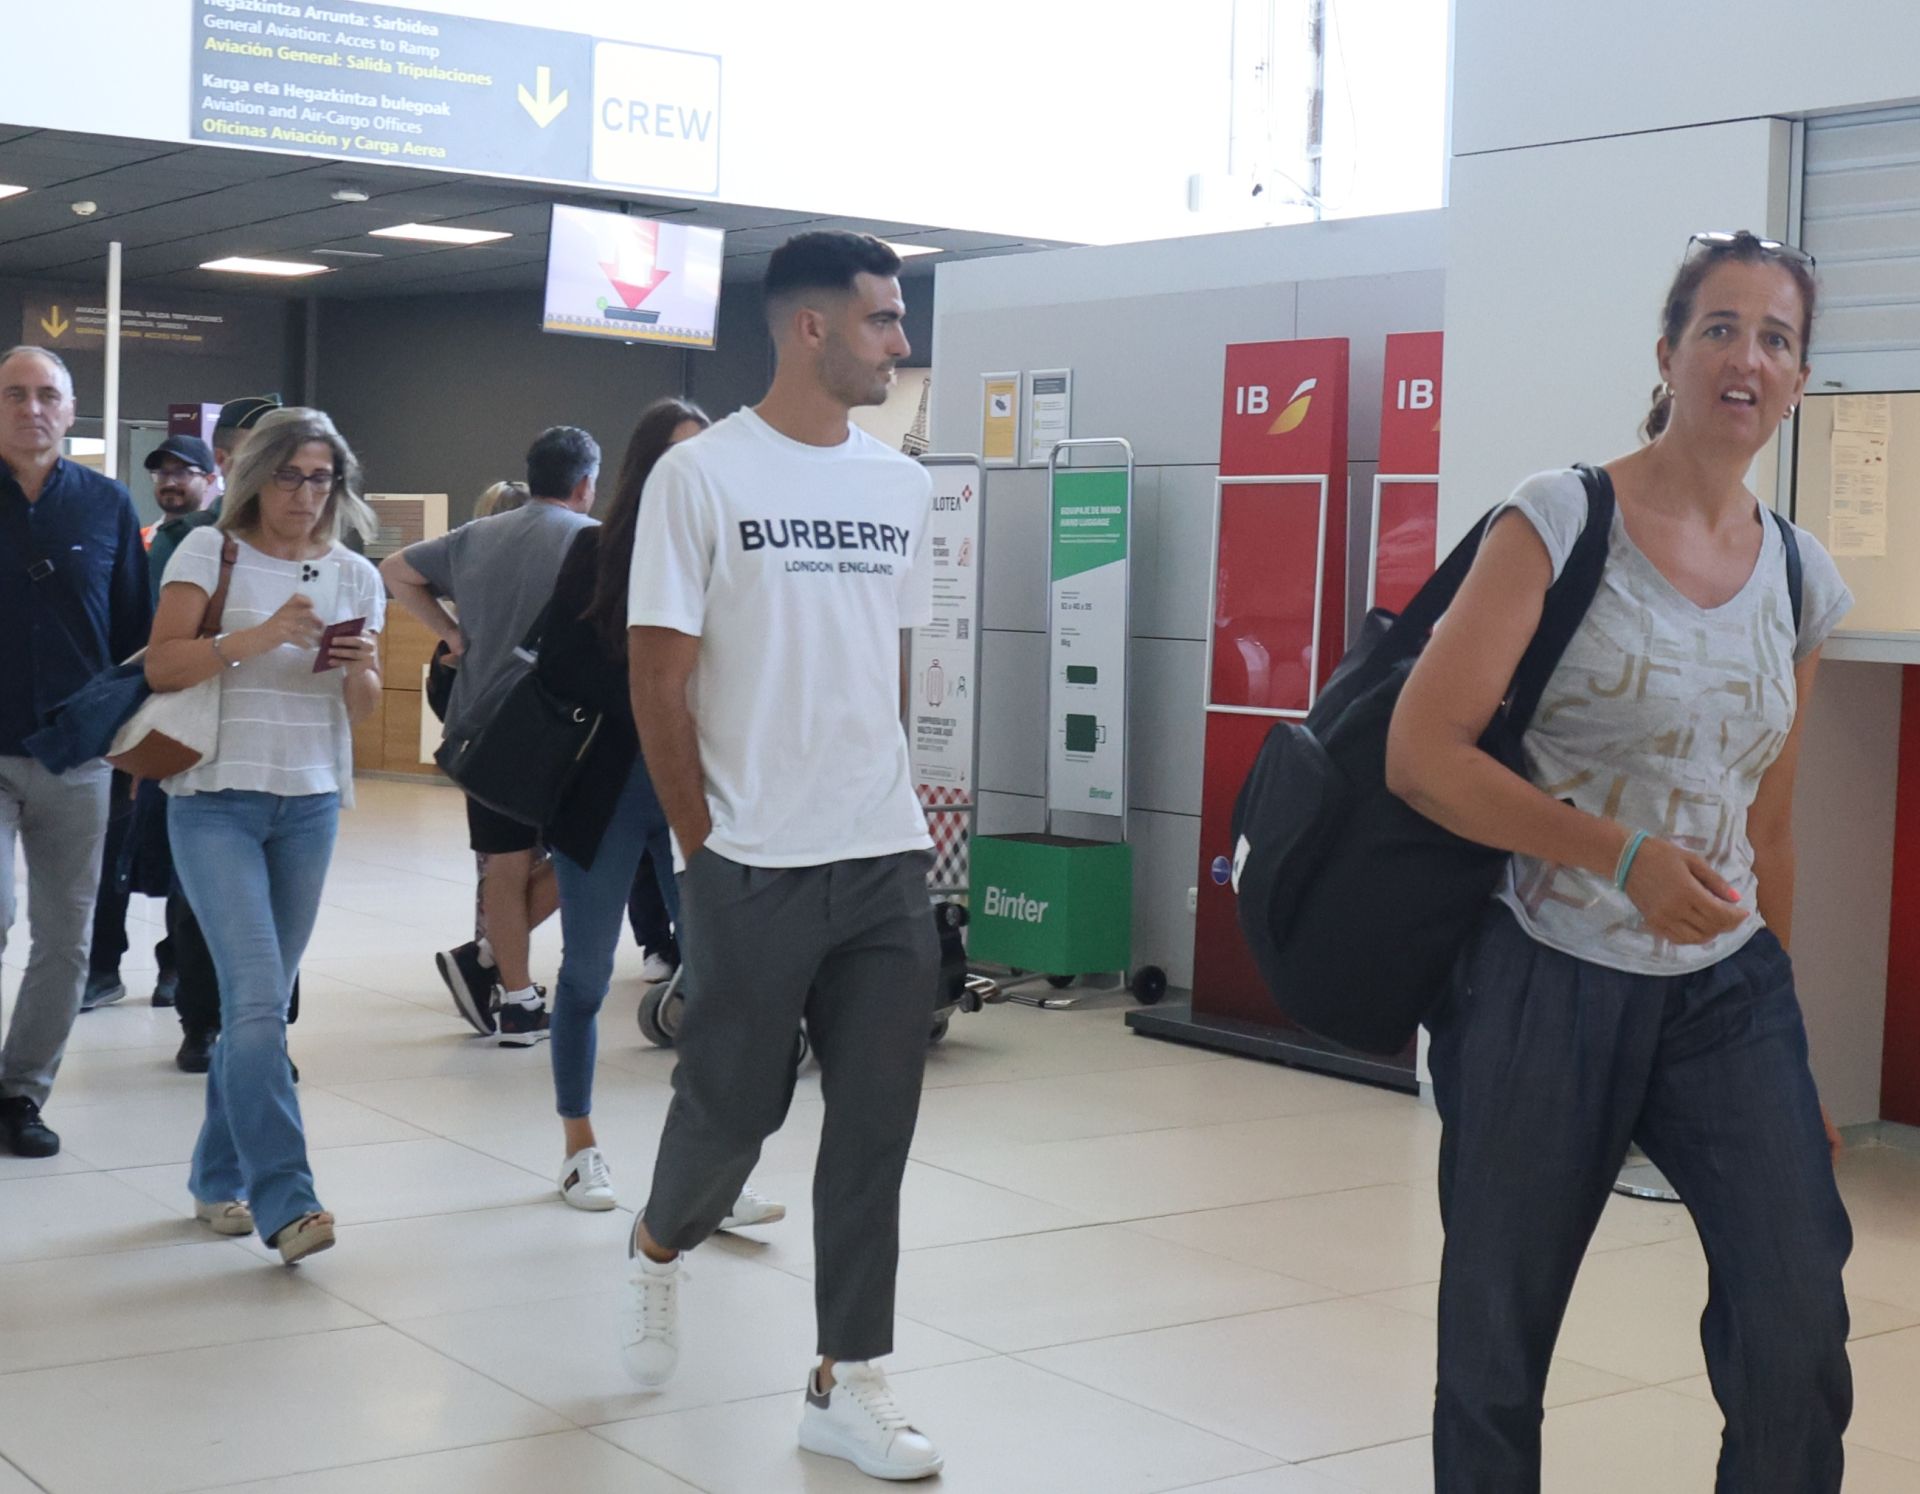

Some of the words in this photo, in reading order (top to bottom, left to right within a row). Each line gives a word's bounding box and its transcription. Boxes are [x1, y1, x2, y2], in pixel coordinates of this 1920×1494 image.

[203, 14, 262, 34] General
[265, 22, 331, 43] Aviation:
[335, 32, 376, 50] Acces
[379, 37, 395, 52] to
[399, 40, 440, 59] Ramp
[304, 6, 369, 28] Arrunta:
[373, 15, 439, 36] Sarbidea
[204, 37, 273, 58] Aviación
[277, 46, 343, 67] General:
[346, 55, 392, 74] Salida
[396, 61, 493, 86] Tripulaciones
[202, 73, 250, 93] Karga
[253, 81, 279, 96] eta
[283, 83, 377, 108] Hegazkintza
[381, 94, 451, 117] bulegoak
[202, 96, 264, 116] Aviation
[268, 105, 297, 119] and
[300, 108, 370, 129] Air-Cargo
[373, 116, 423, 134] Offices
[602, 97, 712, 142] CREW
[202, 118, 268, 138] Oficinas
[270, 126, 337, 146] Aviación
[341, 135, 351, 150] y
[354, 136, 400, 156] Carga
[402, 141, 446, 158] Aerea
[1236, 385, 1269, 415] IB
[1397, 378, 1434, 410] IB
[931, 496, 962, 511] LOTEA
[738, 519, 910, 557] BURBERRY
[785, 561, 834, 573] LONDON
[838, 561, 894, 575] ENGLAND
[983, 886, 1049, 924] Binter
